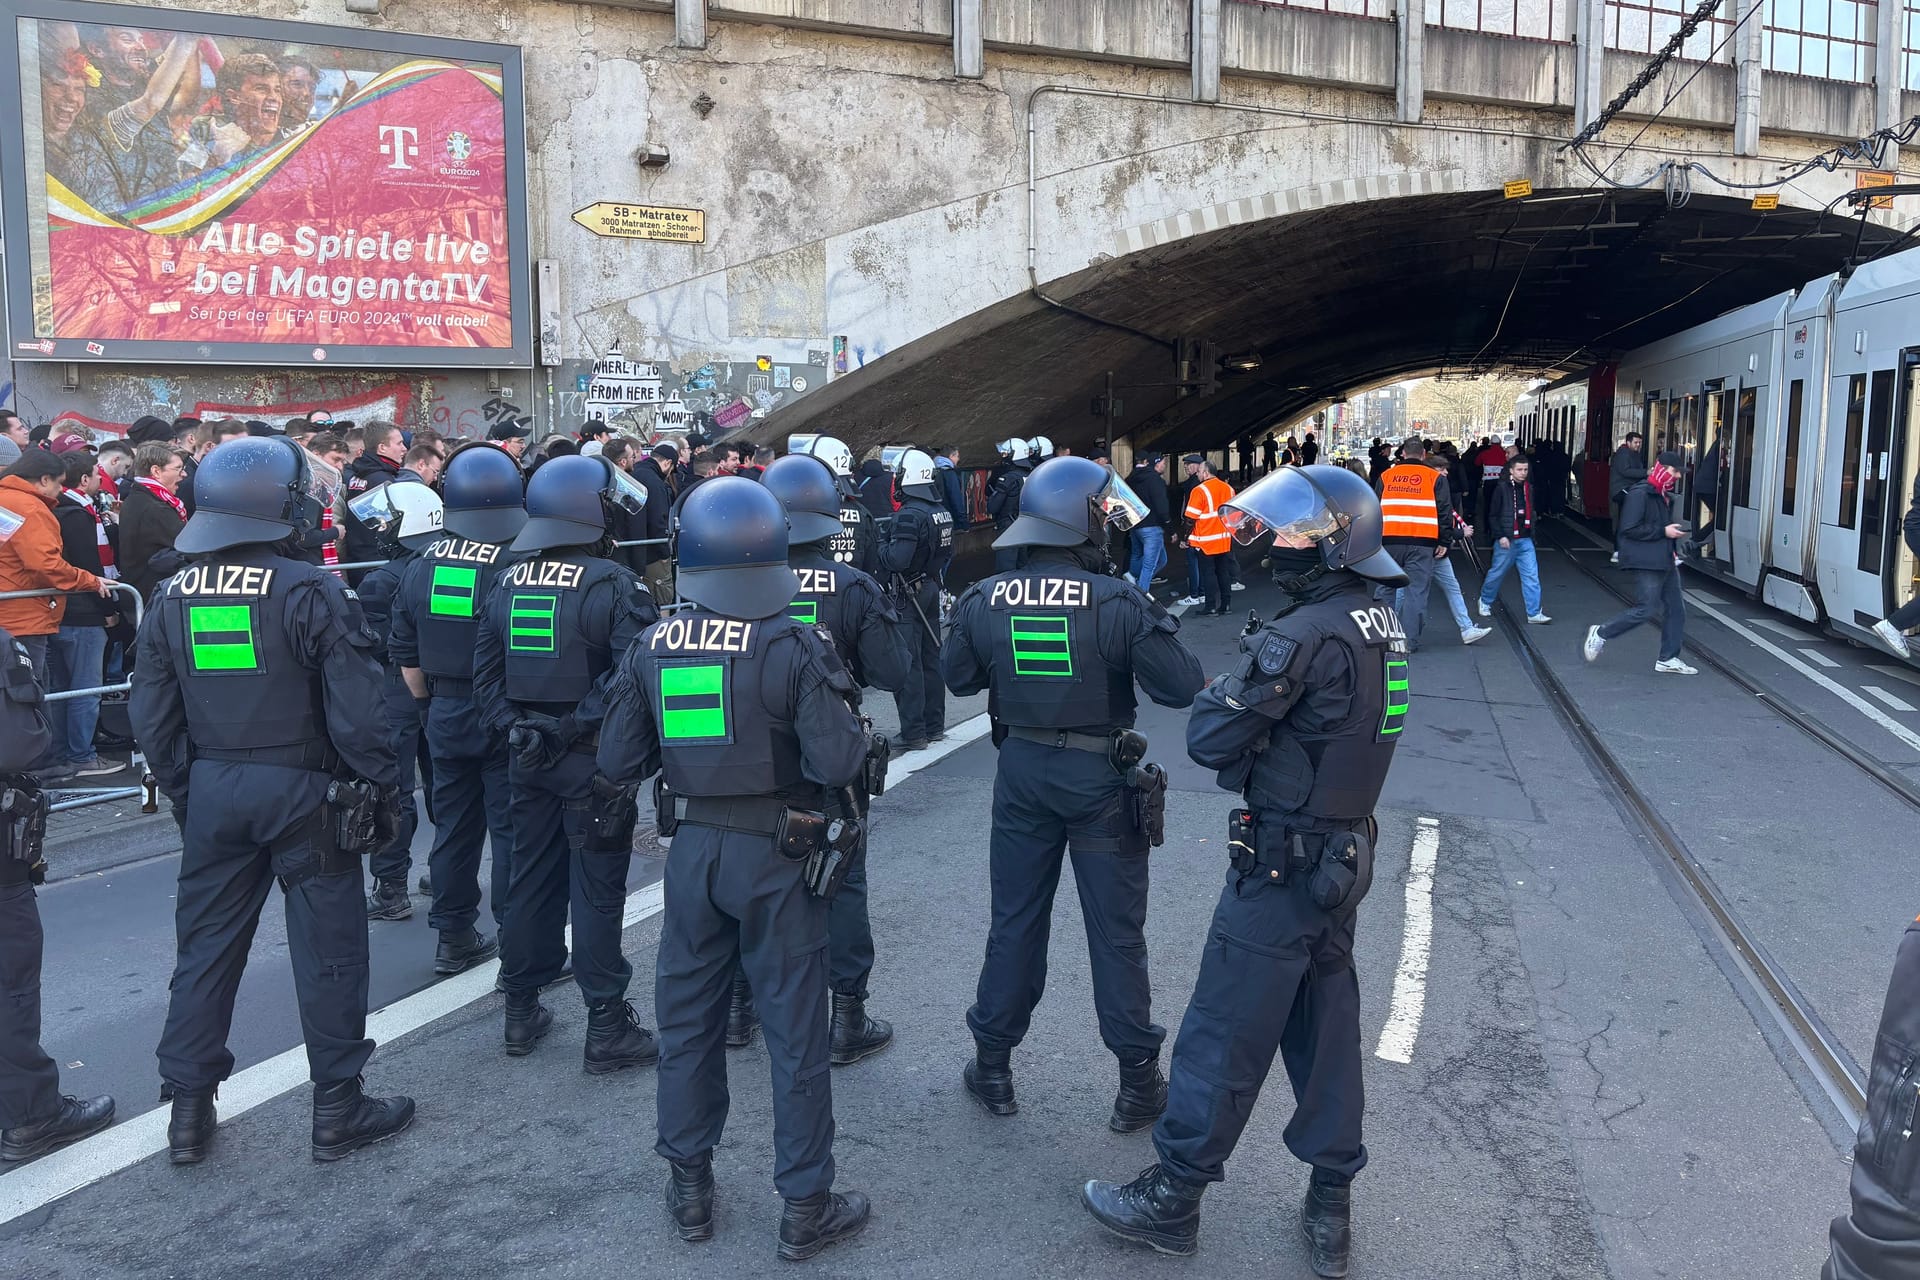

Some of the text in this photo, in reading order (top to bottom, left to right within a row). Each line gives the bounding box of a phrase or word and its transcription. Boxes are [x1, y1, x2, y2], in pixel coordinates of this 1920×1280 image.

[379, 125, 418, 169] T
[601, 217, 619, 226] 3000
[621, 219, 660, 230] Matratzen
[613, 207, 629, 217] SB
[639, 209, 689, 222] Matratex
[609, 225, 689, 239] Rahmen abholbereit
[200, 221, 490, 265] Alle Spiele live
[194, 263, 490, 306] bei MagentaTV
[189, 306, 213, 321] Sei
[217, 306, 241, 321] bei
[246, 308, 271, 321] der
[276, 310, 315, 322] UEFA
[319, 310, 360, 324] EURO
[416, 313, 442, 326] voll
[445, 314, 489, 327] dabei!
[591, 385, 622, 400] FROM
[627, 386, 654, 400] HERE
[833, 455, 848, 468] 12
[920, 469, 931, 479] 12
[427, 509, 442, 527] 12
[424, 539, 501, 564] POLIZEI
[830, 539, 856, 551] 31212
[166, 565, 273, 596] POLIZEI
[502, 561, 584, 588] POLIZEI
[990, 578, 1088, 606] POLIZEI
[651, 619, 751, 652] POLIZEI
[1269, 635, 1293, 650] POLIZEI
